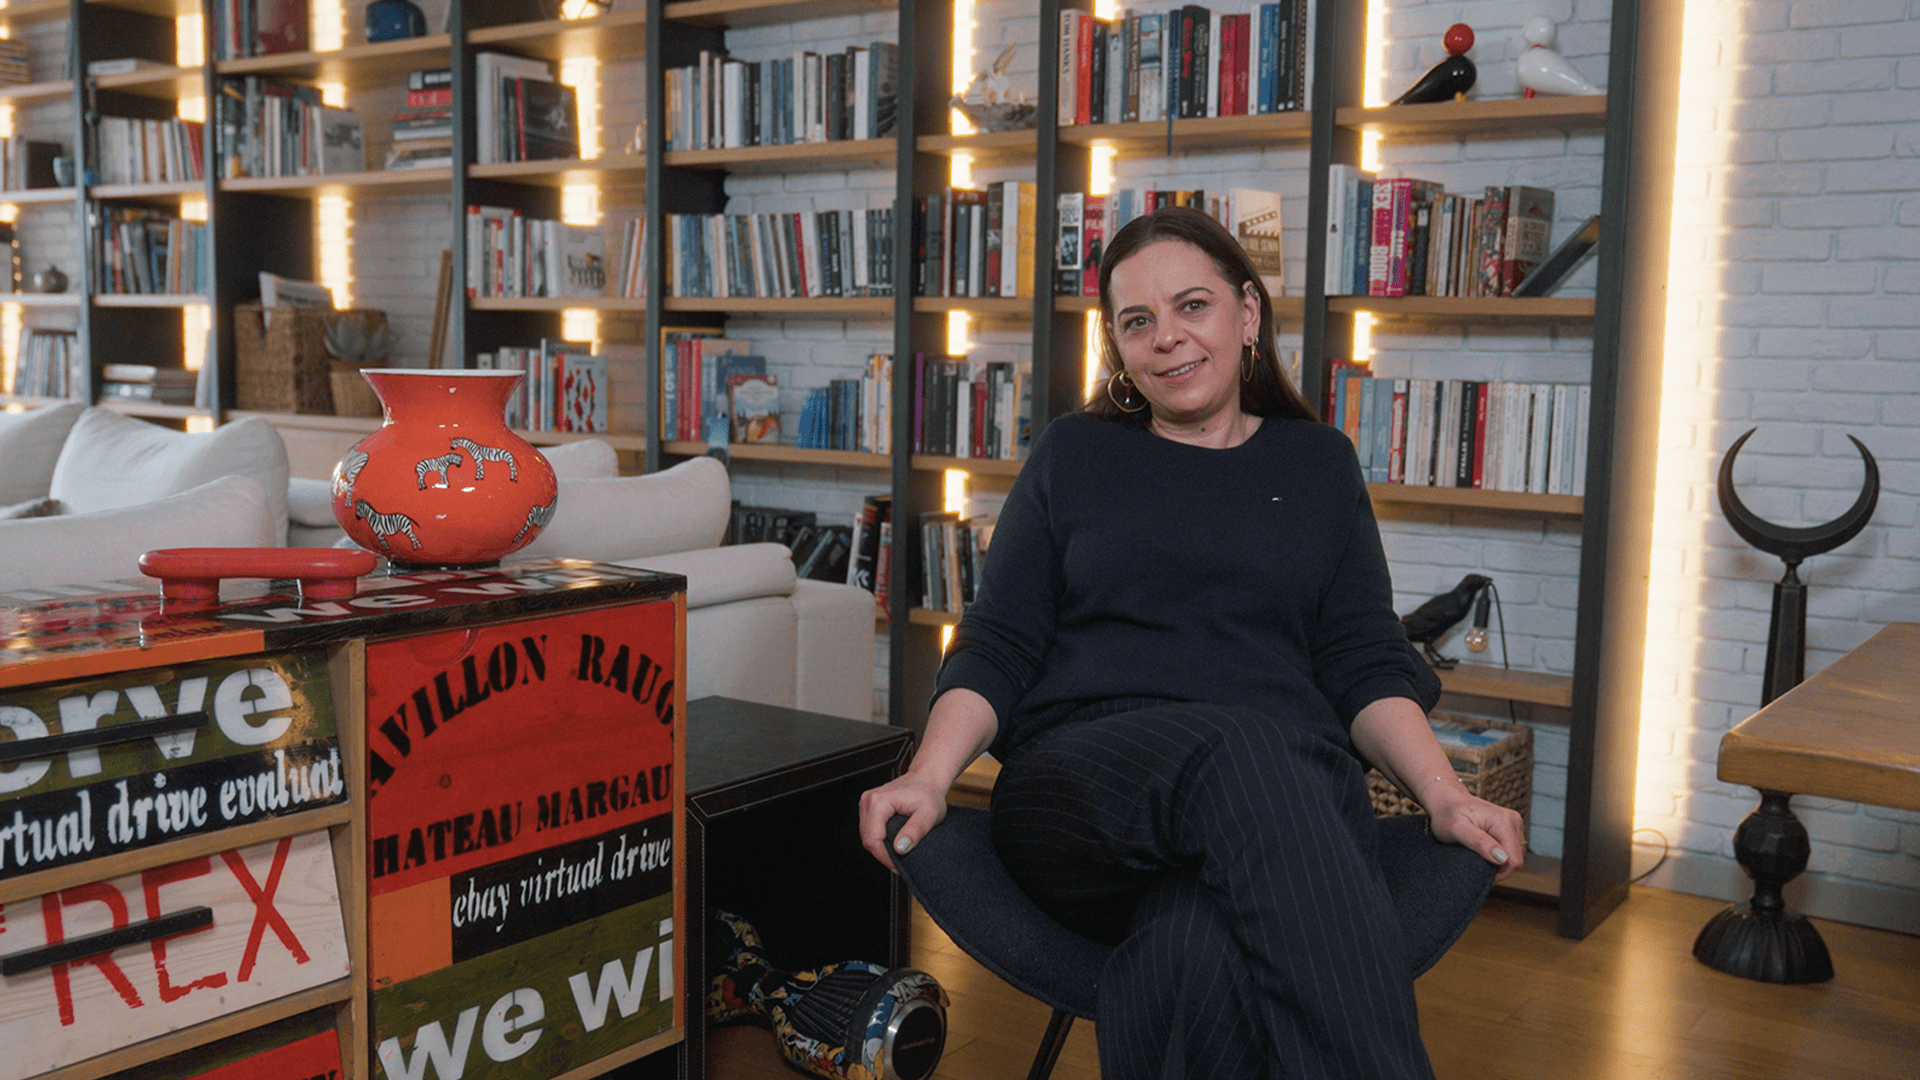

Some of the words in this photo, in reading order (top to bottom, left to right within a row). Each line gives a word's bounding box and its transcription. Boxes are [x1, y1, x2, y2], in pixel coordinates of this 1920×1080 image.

[1373, 182, 1392, 209] SEX
[1369, 245, 1389, 281] BOOK
[577, 634, 674, 740] RAUG
[108, 772, 207, 844] drive
[373, 801, 523, 879] HATEAU
[536, 763, 673, 833] MARGAU
[41, 836, 311, 1027] REX
[452, 877, 510, 933] ebay
[520, 841, 604, 907] virtual
[610, 828, 671, 882] drive
[377, 987, 545, 1080] we
[568, 917, 674, 1033] wi
